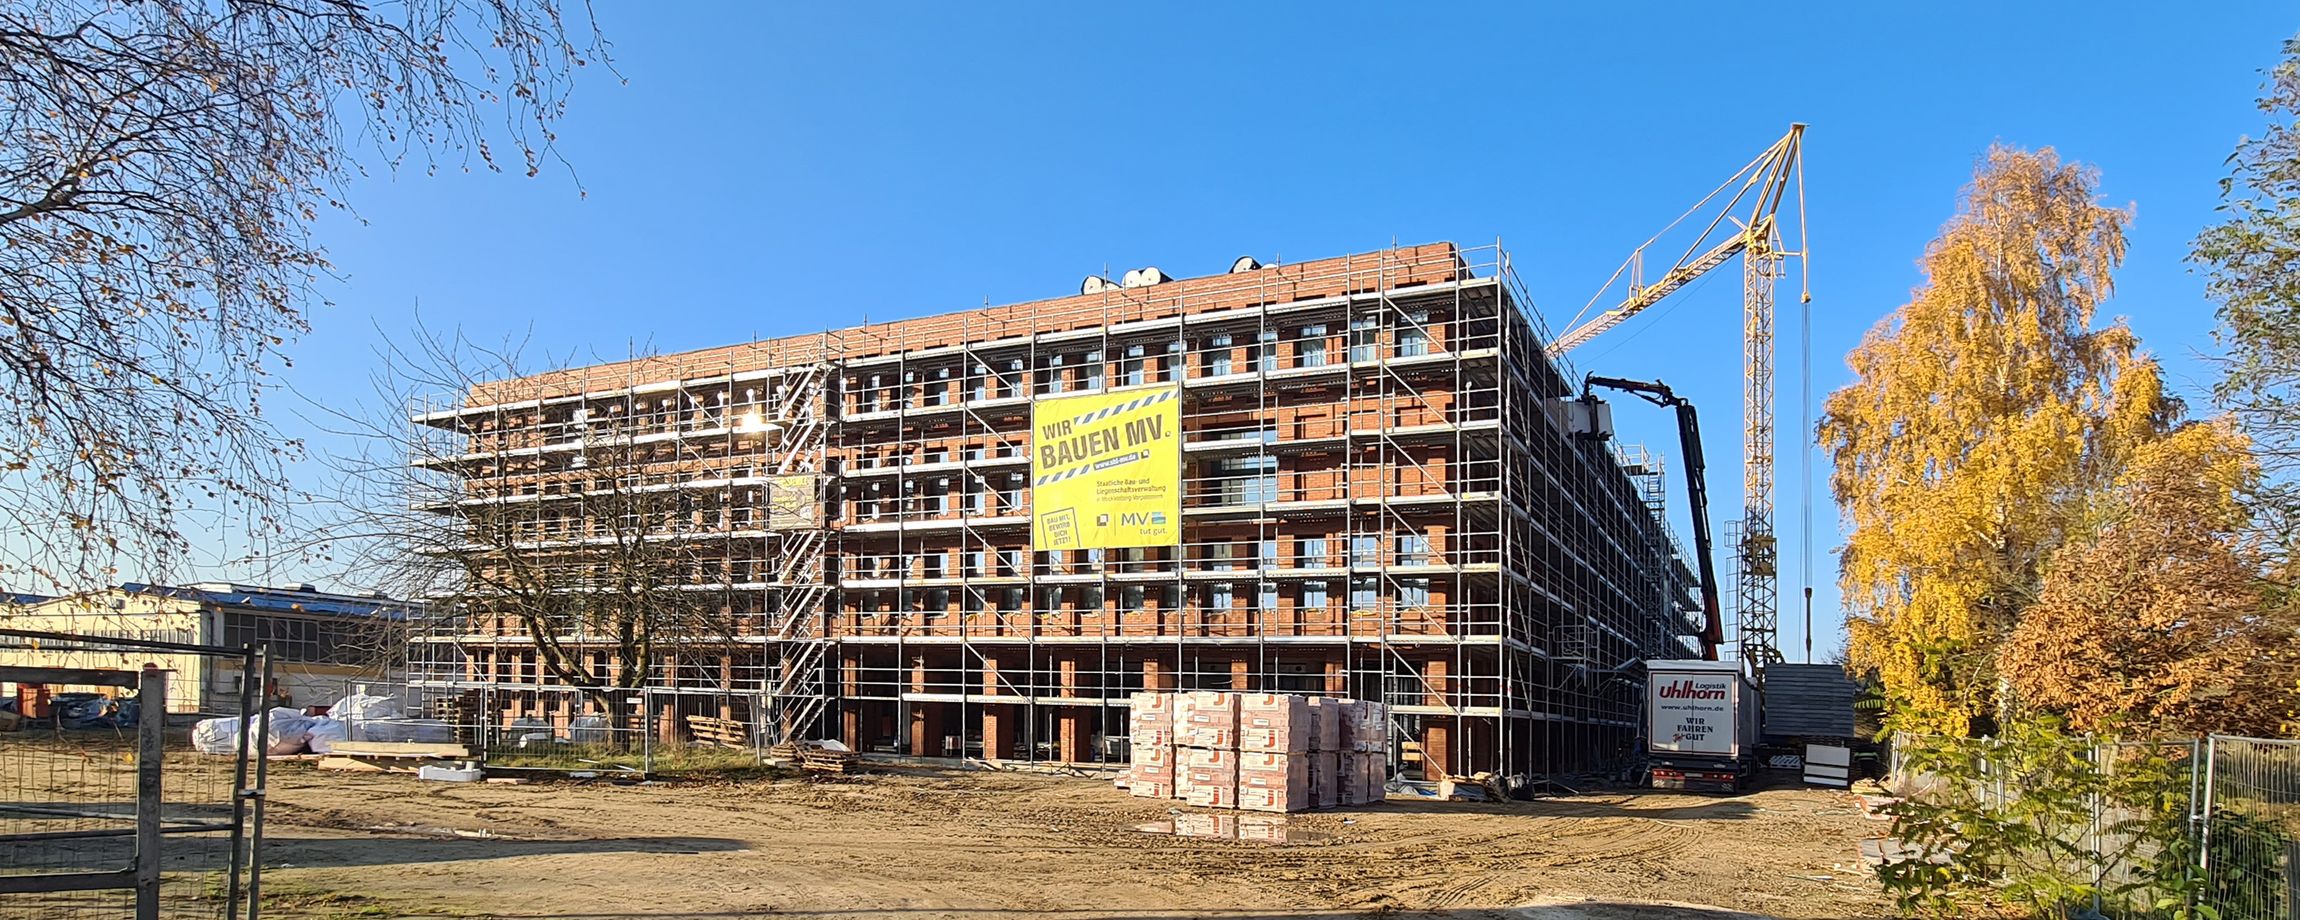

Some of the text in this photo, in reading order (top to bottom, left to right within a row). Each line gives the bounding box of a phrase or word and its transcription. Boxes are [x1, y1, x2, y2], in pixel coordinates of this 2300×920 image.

[1042, 419, 1072, 440] WIR
[1040, 426, 1120, 470] BAUEN
[1121, 512, 1149, 526] MV
[1153, 528, 1168, 536] gut.
[1659, 680, 1725, 700] uhlhorn
[1695, 682, 1726, 690] Logistik
[1661, 704, 1724, 712] www.uhlhorn.de
[1685, 717, 1705, 725] WIR
[1677, 724, 1713, 733] FAHREN
[1685, 733, 1705, 741] GUT
